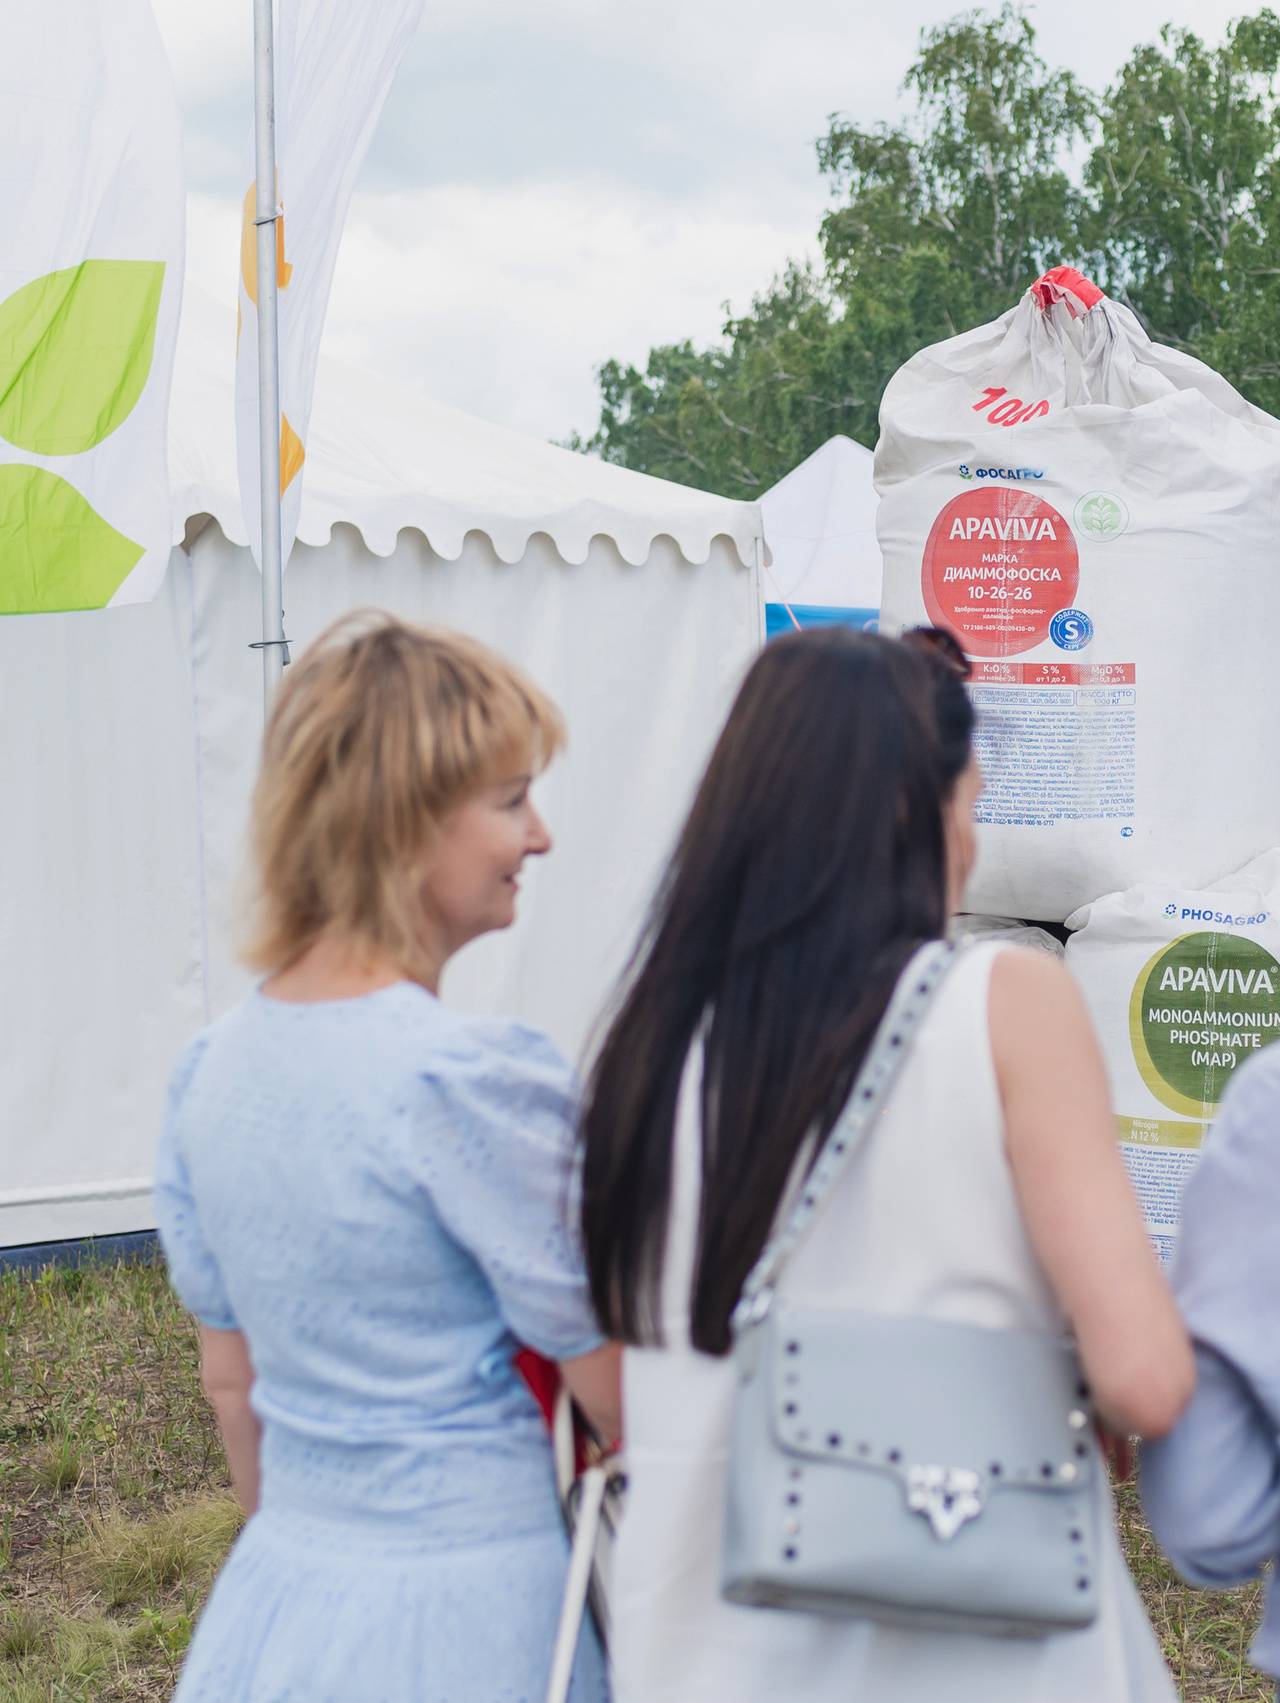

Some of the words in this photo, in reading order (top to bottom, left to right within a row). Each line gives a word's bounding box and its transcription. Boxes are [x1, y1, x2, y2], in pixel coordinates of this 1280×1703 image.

[982, 554, 1018, 563] МАРКА
[943, 567, 1062, 582] ДИАММОФОСКА
[968, 586, 1032, 600] 10-26-26
[1065, 621, 1078, 640] S
[1043, 666, 1048, 674] S
[1051, 666, 1059, 674] %
[1115, 666, 1123, 674] %
[1170, 1030, 1261, 1047] PHOSPHATE
[1191, 1051, 1237, 1069] (MAP)
[1133, 1120, 1159, 1130] Nitrogen
[1131, 1130, 1137, 1140] N
[1140, 1131, 1148, 1141] 12
[1150, 1132, 1159, 1142] %
